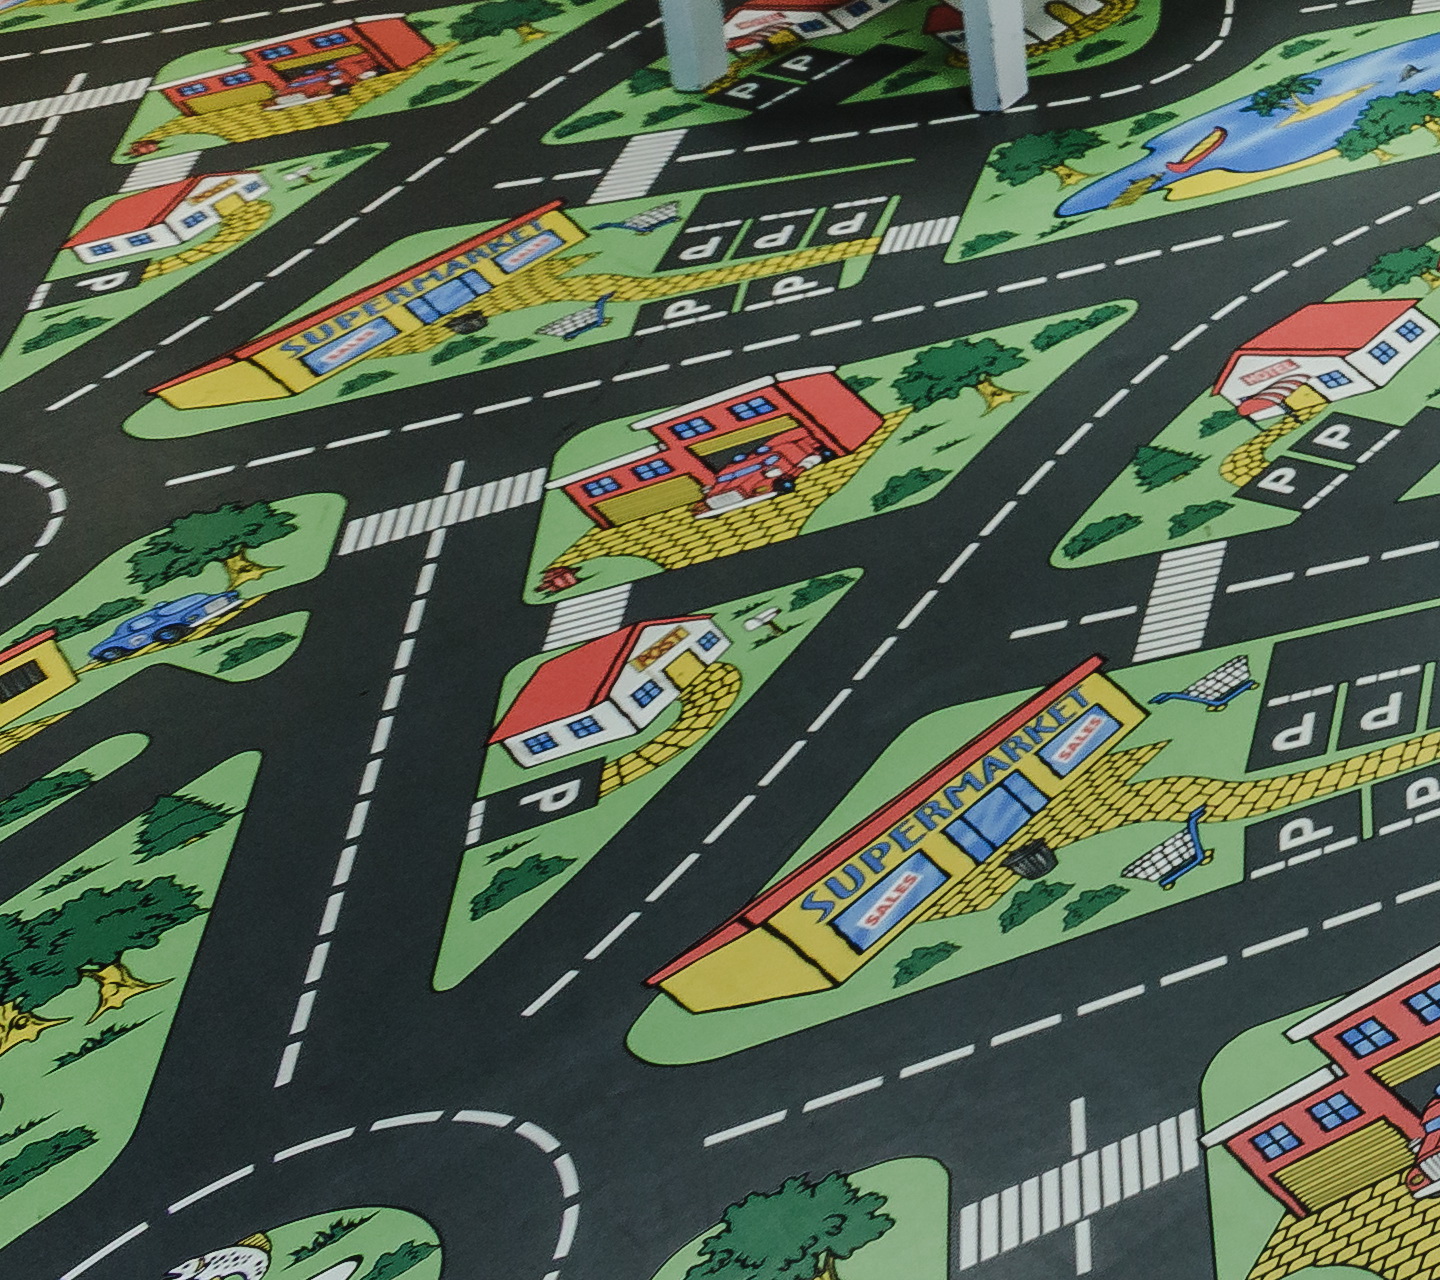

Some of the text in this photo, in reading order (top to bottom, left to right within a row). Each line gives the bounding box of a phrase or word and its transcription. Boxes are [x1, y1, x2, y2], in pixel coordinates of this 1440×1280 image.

[279, 218, 545, 357] SUPERMARKET
[1242, 358, 1302, 388] HOTEL
[631, 626, 690, 672] POST
[1273, 713, 1315, 751] P
[1361, 692, 1402, 730] P
[1057, 715, 1102, 762] SALES
[800, 684, 1096, 925] SUPERMARKET
[1280, 818, 1333, 851] P
[866, 872, 918, 929] SALES
